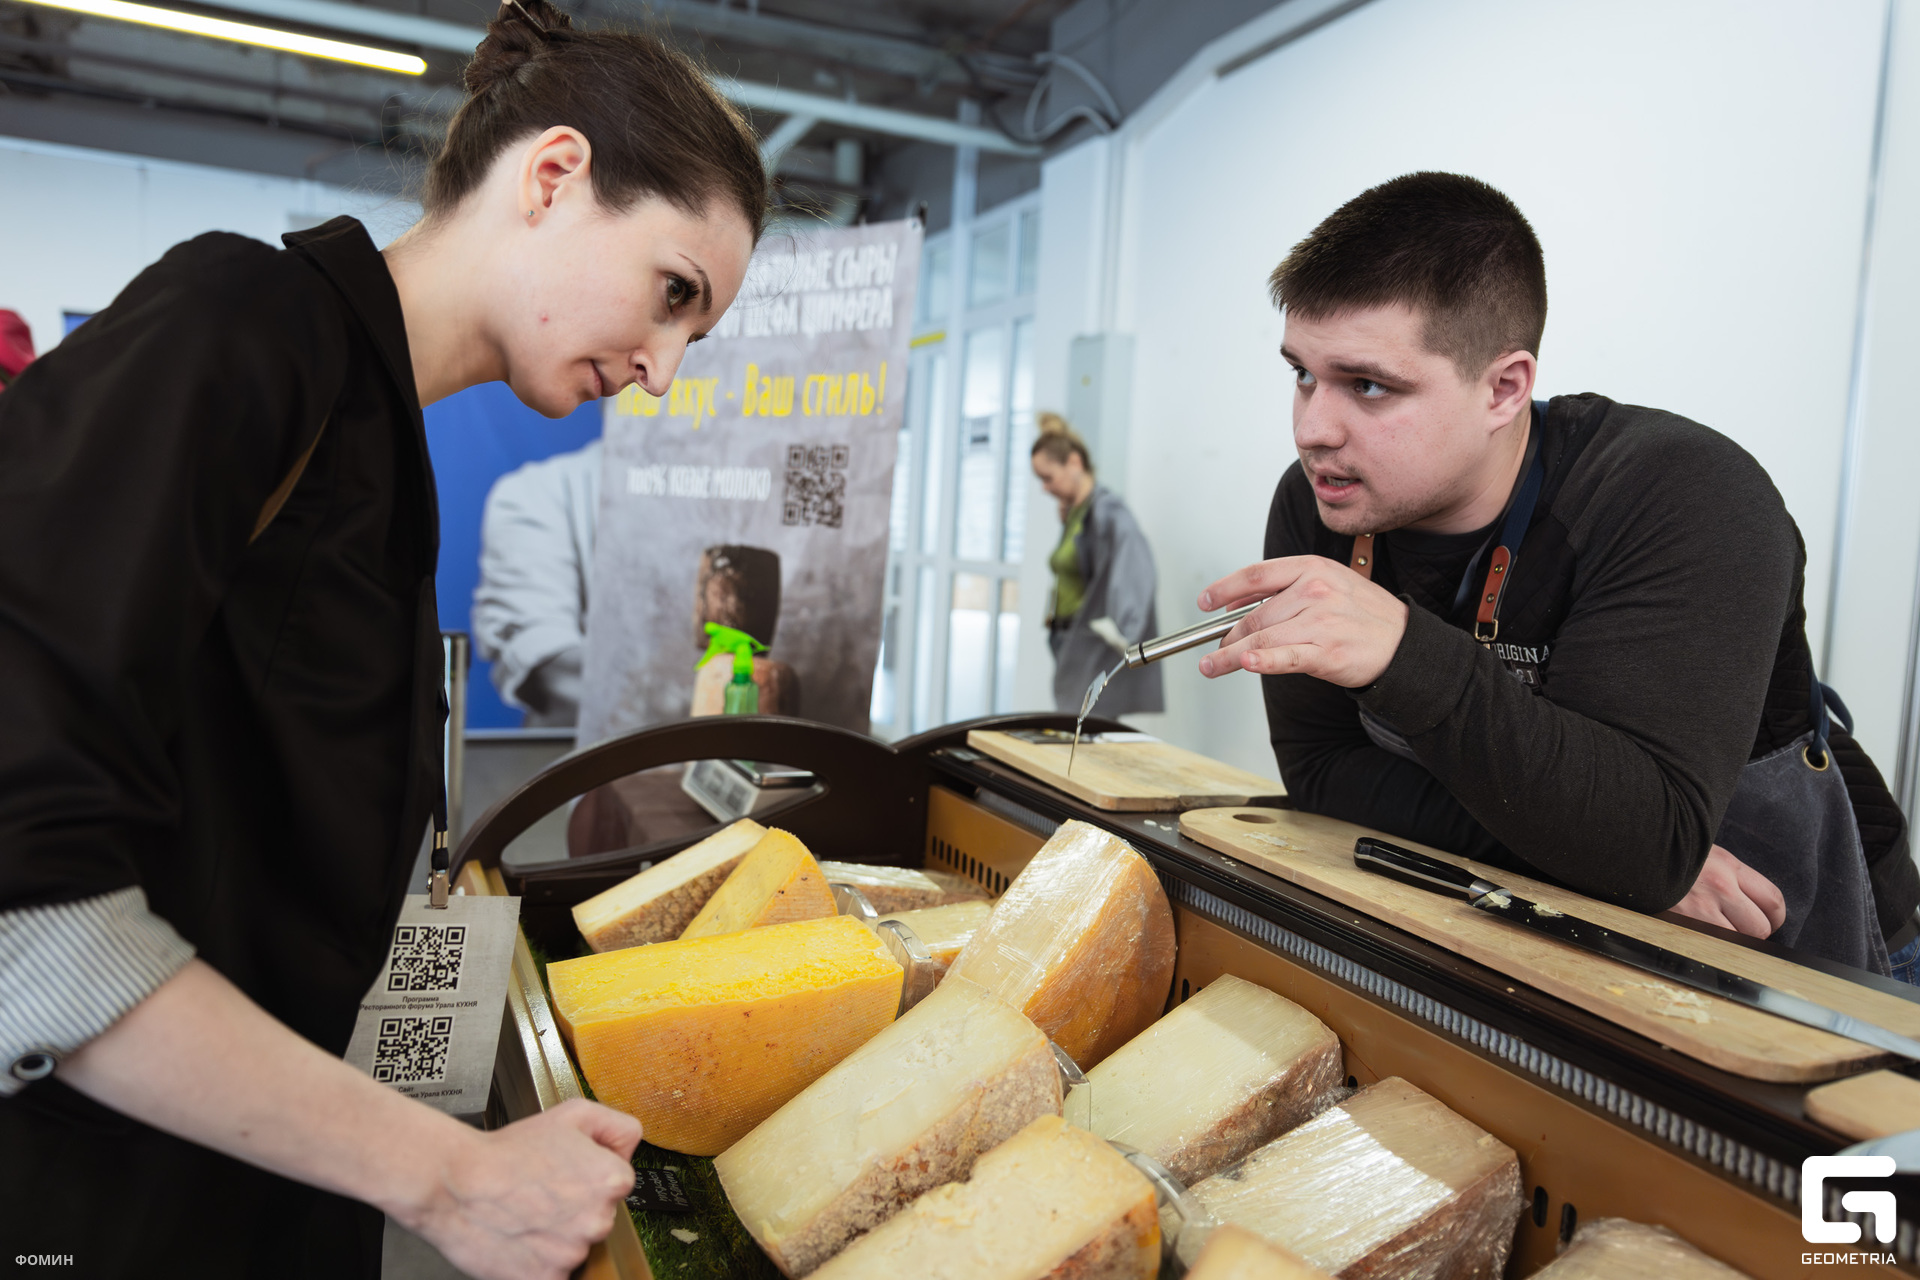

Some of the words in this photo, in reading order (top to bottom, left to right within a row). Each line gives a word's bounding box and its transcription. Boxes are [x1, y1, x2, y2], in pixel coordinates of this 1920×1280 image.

[834, 242, 898, 289] СЫРЫ
[667, 376, 719, 431] вкус
[741, 363, 796, 418] Ваш
[801, 361, 888, 418] стиль!
[402, 995, 439, 1004] Программа
[360, 1003, 406, 1011] Ресторанного
[407, 1002, 434, 1011] форума
[435, 1002, 455, 1010] Урала
[420, 1091, 440, 1099] Урала
